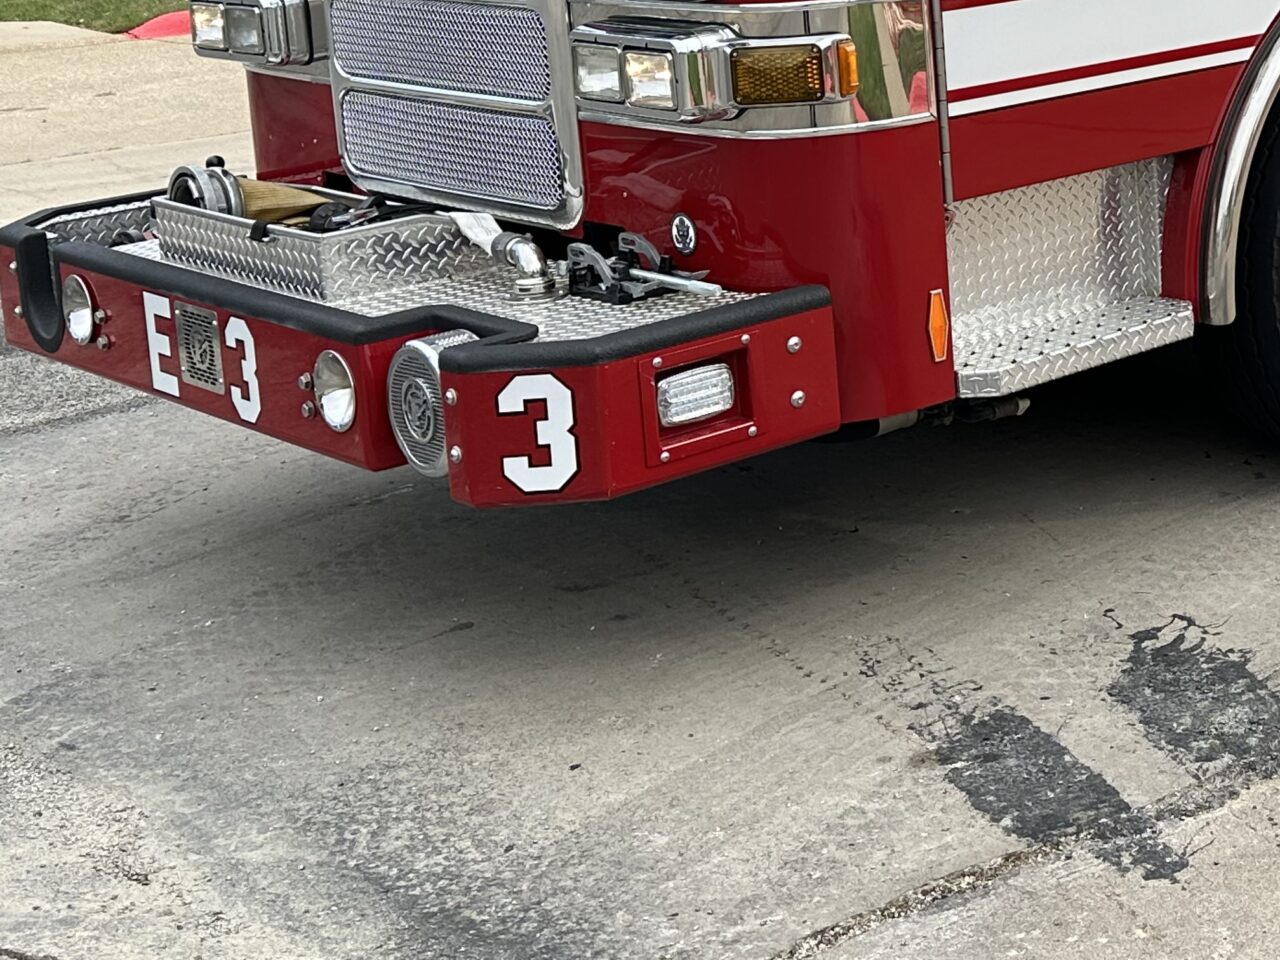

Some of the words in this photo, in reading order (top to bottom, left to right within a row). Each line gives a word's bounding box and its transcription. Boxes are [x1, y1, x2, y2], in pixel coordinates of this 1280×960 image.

[142, 290, 180, 398] E
[224, 316, 261, 425] 3
[497, 373, 578, 493] 3
